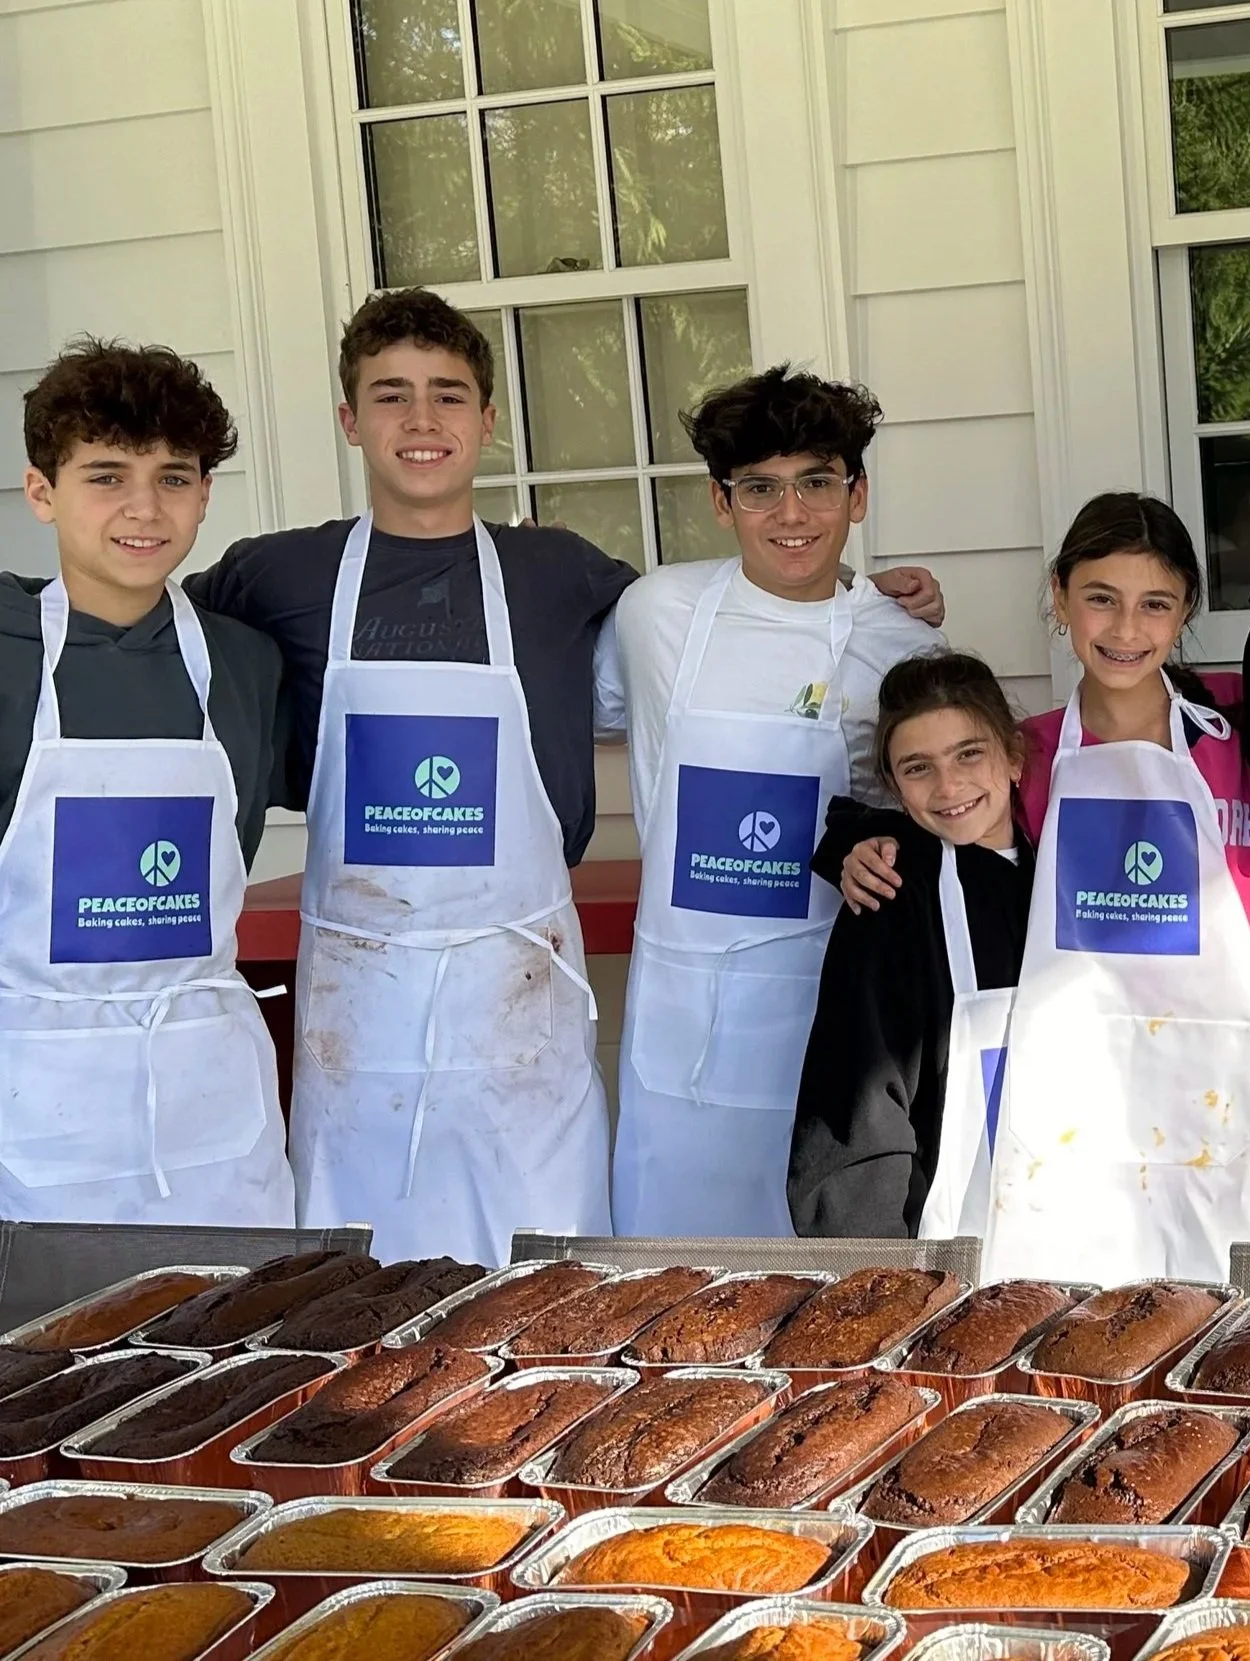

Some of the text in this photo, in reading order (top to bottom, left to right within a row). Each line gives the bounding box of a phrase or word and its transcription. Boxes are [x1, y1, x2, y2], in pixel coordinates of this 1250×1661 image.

[364, 805, 484, 821] PEACEOFCAKES
[364, 823, 484, 836] Baking cakes, sharing peace
[691, 853, 801, 876] PEACEOFCAKES
[689, 869, 714, 883] Baking
[715, 874, 740, 885] cakes,
[743, 876, 773, 888] sharing
[78, 893, 201, 914] PEACEOFCAKES
[1076, 891, 1189, 909] PEACEOFCAKES
[77, 914, 202, 929] Baking cakes, sharing peace
[1105, 910, 1129, 921] cakes,
[1131, 911, 1160, 923] sharing
[1161, 913, 1189, 923] peace
